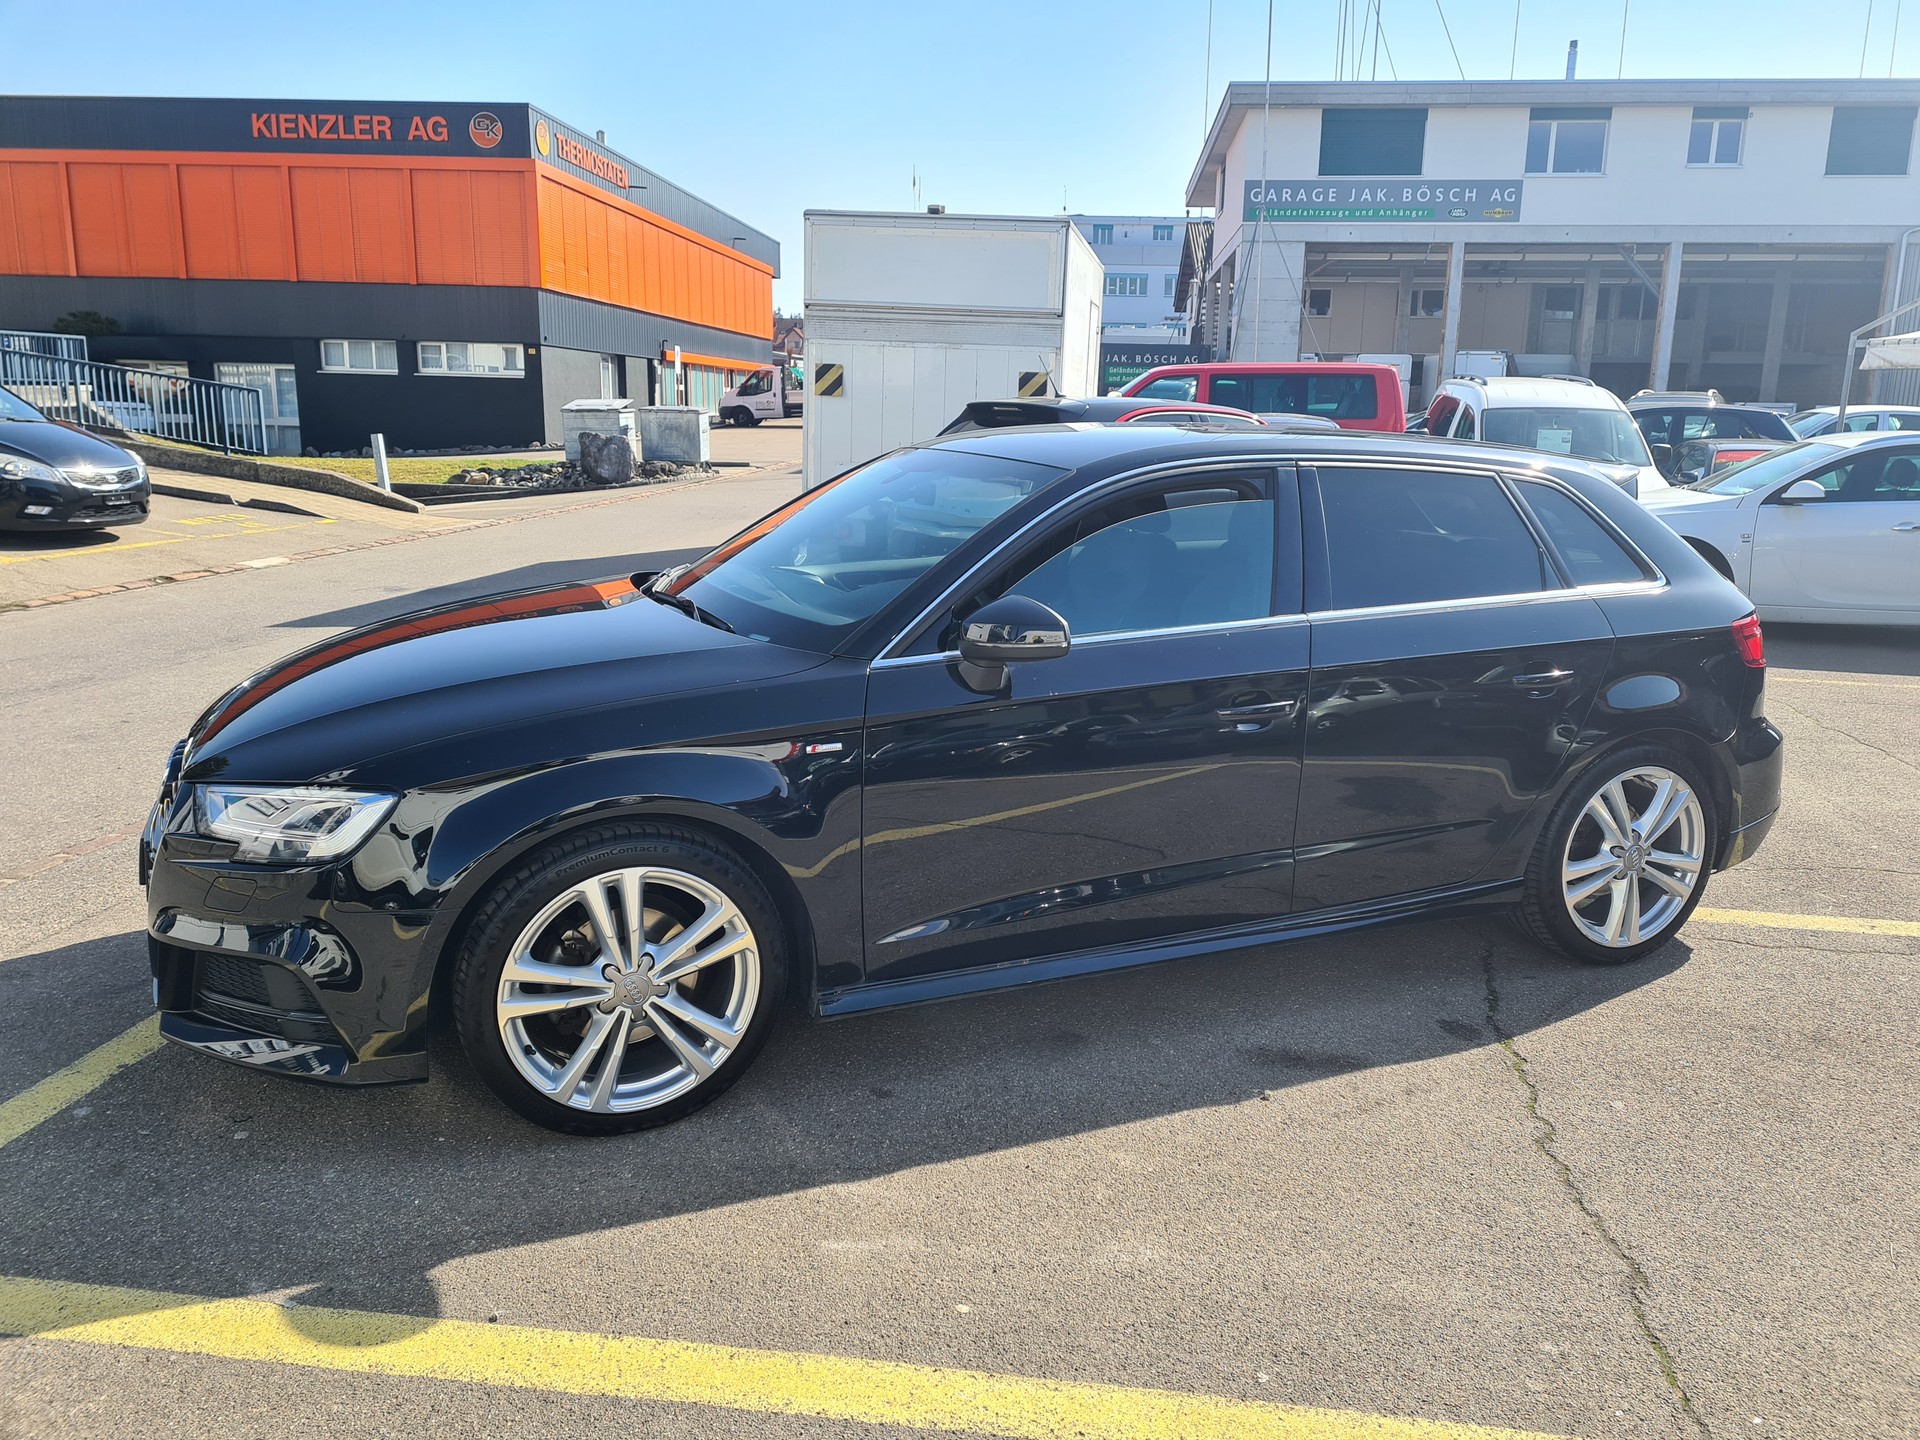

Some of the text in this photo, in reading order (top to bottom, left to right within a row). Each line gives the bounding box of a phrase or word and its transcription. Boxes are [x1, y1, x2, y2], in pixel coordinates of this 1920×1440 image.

[251, 113, 449, 142] KIENZLER AG
[555, 132, 629, 190] THERMOSTATEN
[1250, 185, 1516, 202] GARAGE JAK. BÖSCH AG
[1355, 208, 1373, 216] und
[1379, 208, 1428, 219] Anhänger
[1105, 353, 1199, 364] JAK. BÖSCH AG
[554, 845, 658, 878] PremiumContact
